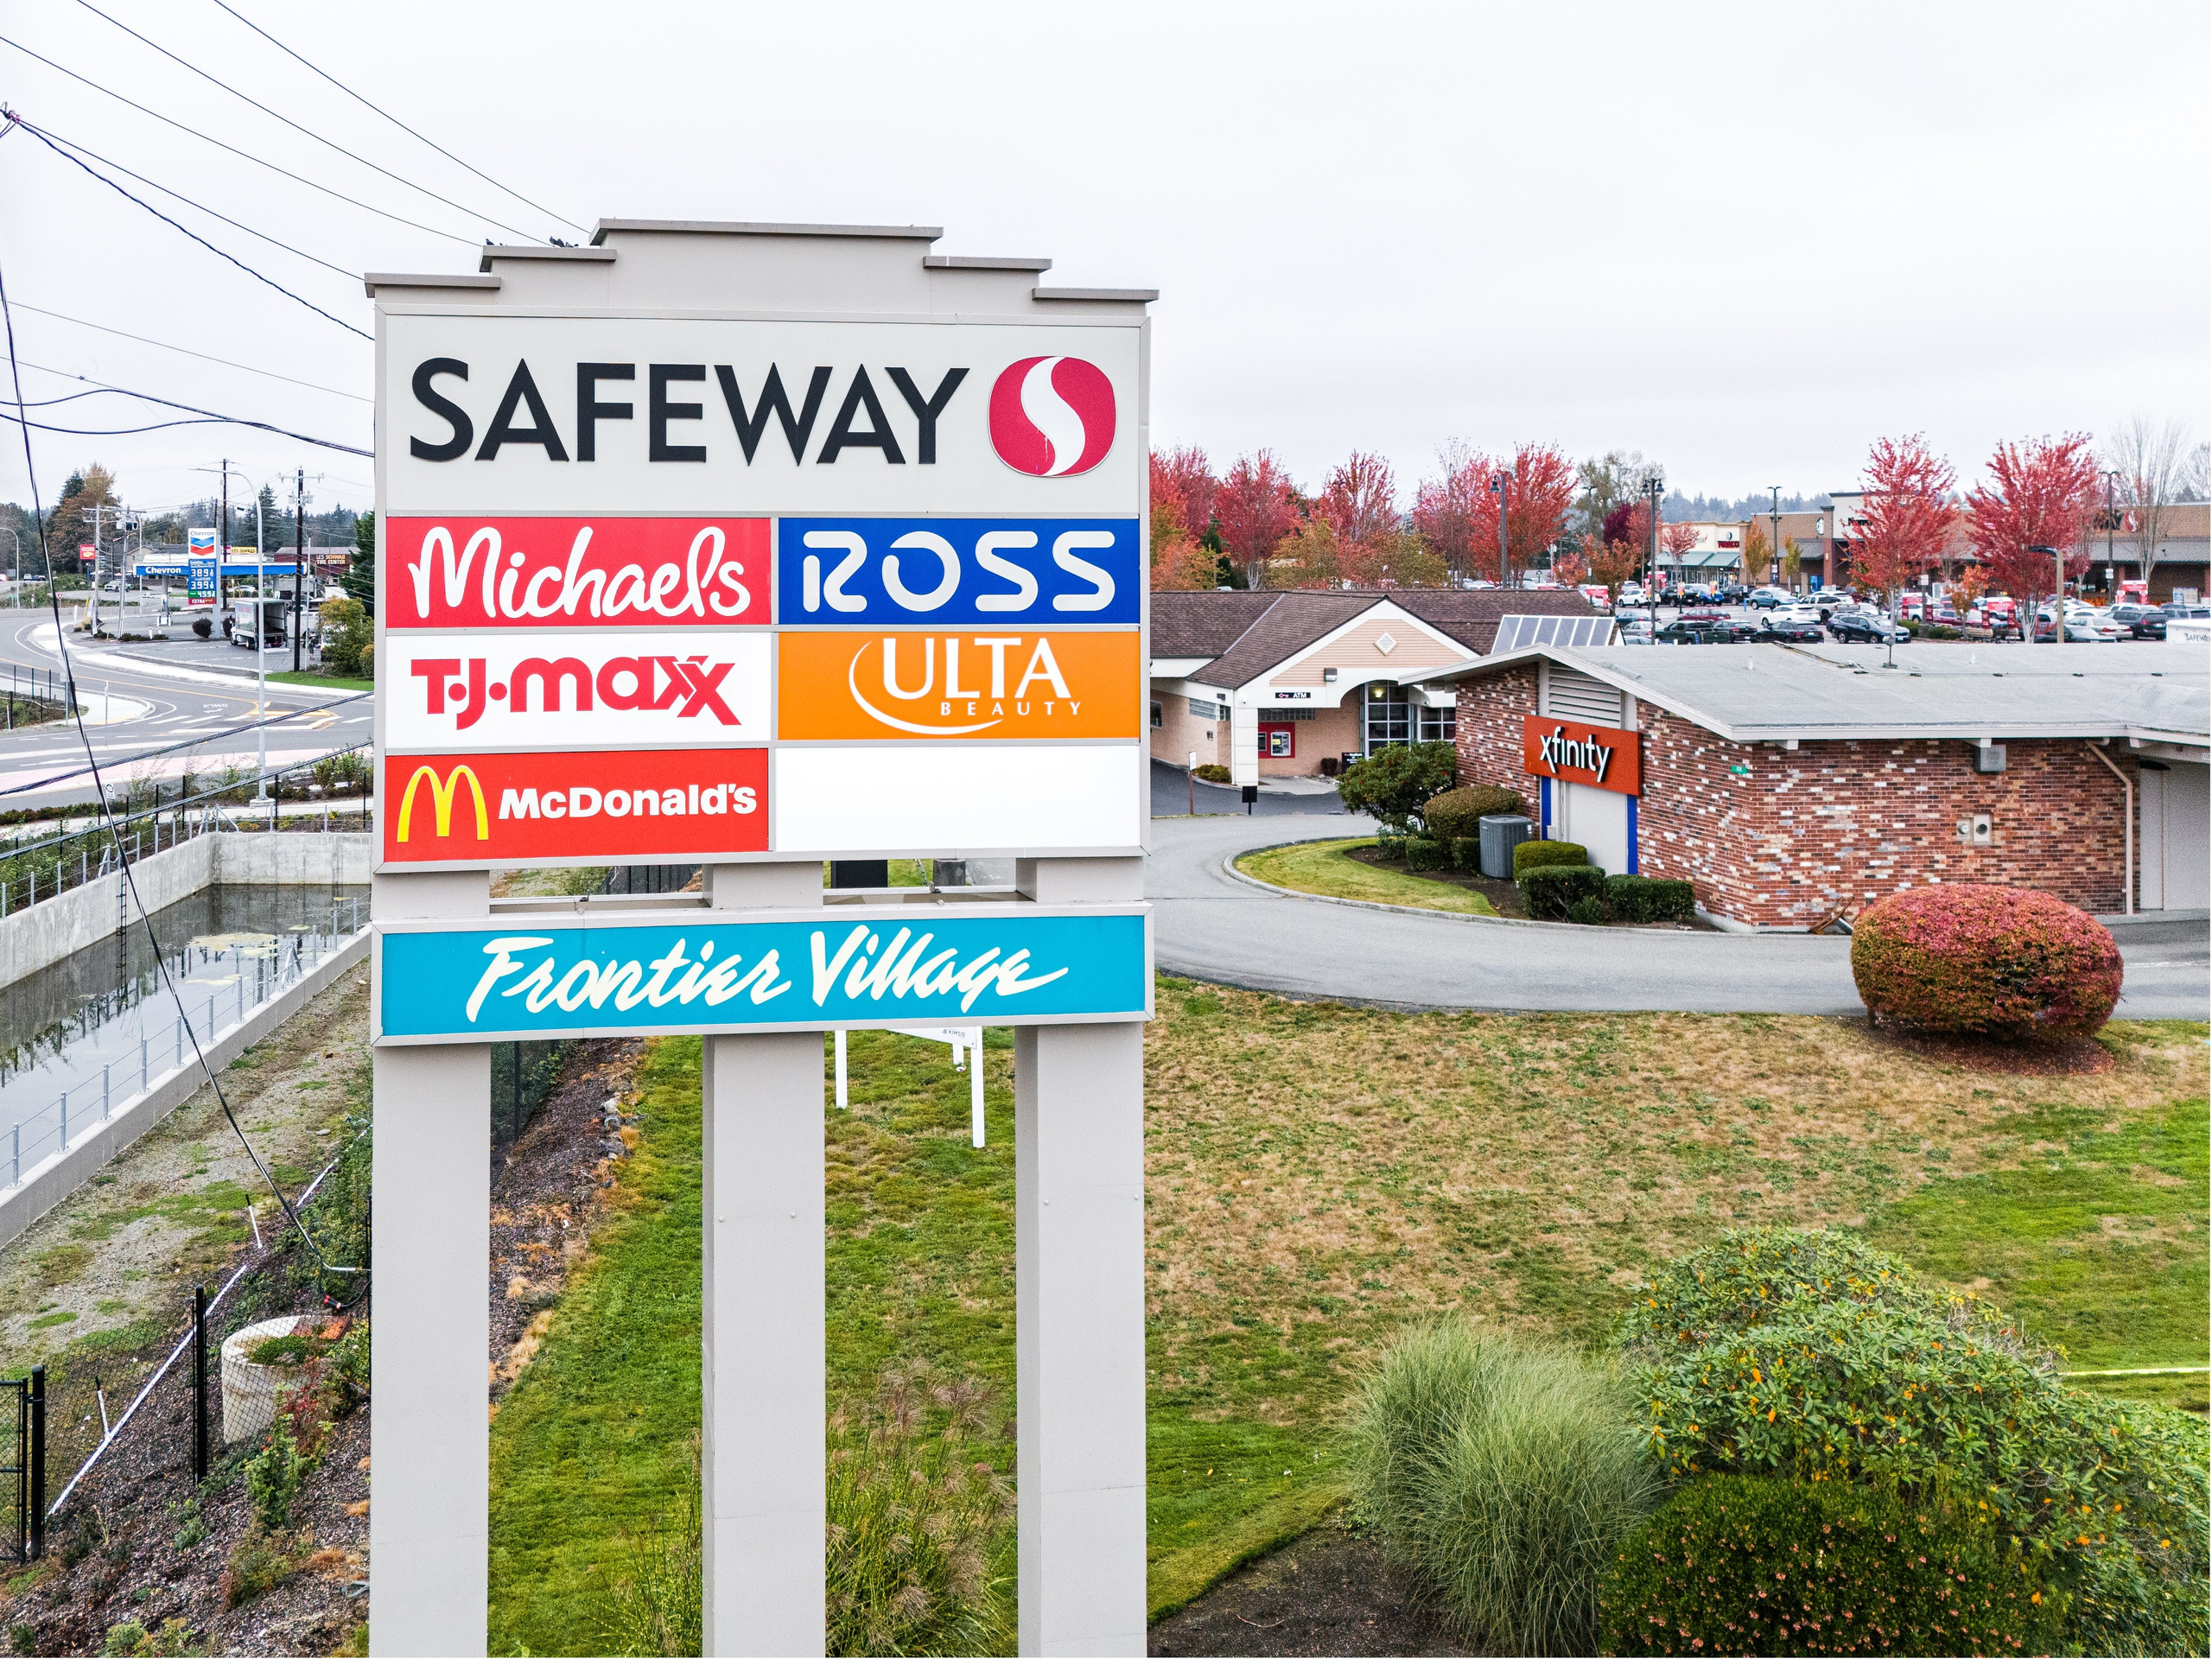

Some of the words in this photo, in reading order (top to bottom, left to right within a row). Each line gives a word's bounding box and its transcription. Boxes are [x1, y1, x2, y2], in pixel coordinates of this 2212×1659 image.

[410, 357, 970, 467] SAFEWAY
[144, 565, 181, 575] Chevron
[408, 526, 751, 619] Michaels
[803, 531, 1116, 613] ROSS
[882, 637, 1072, 700] ULTA
[940, 701, 1082, 716] BEAUTY
[1539, 726, 1612, 783] xfinity
[498, 783, 757, 820] McDonald's
[465, 936, 792, 1022] Frontier
[810, 924, 1070, 1014] Village
